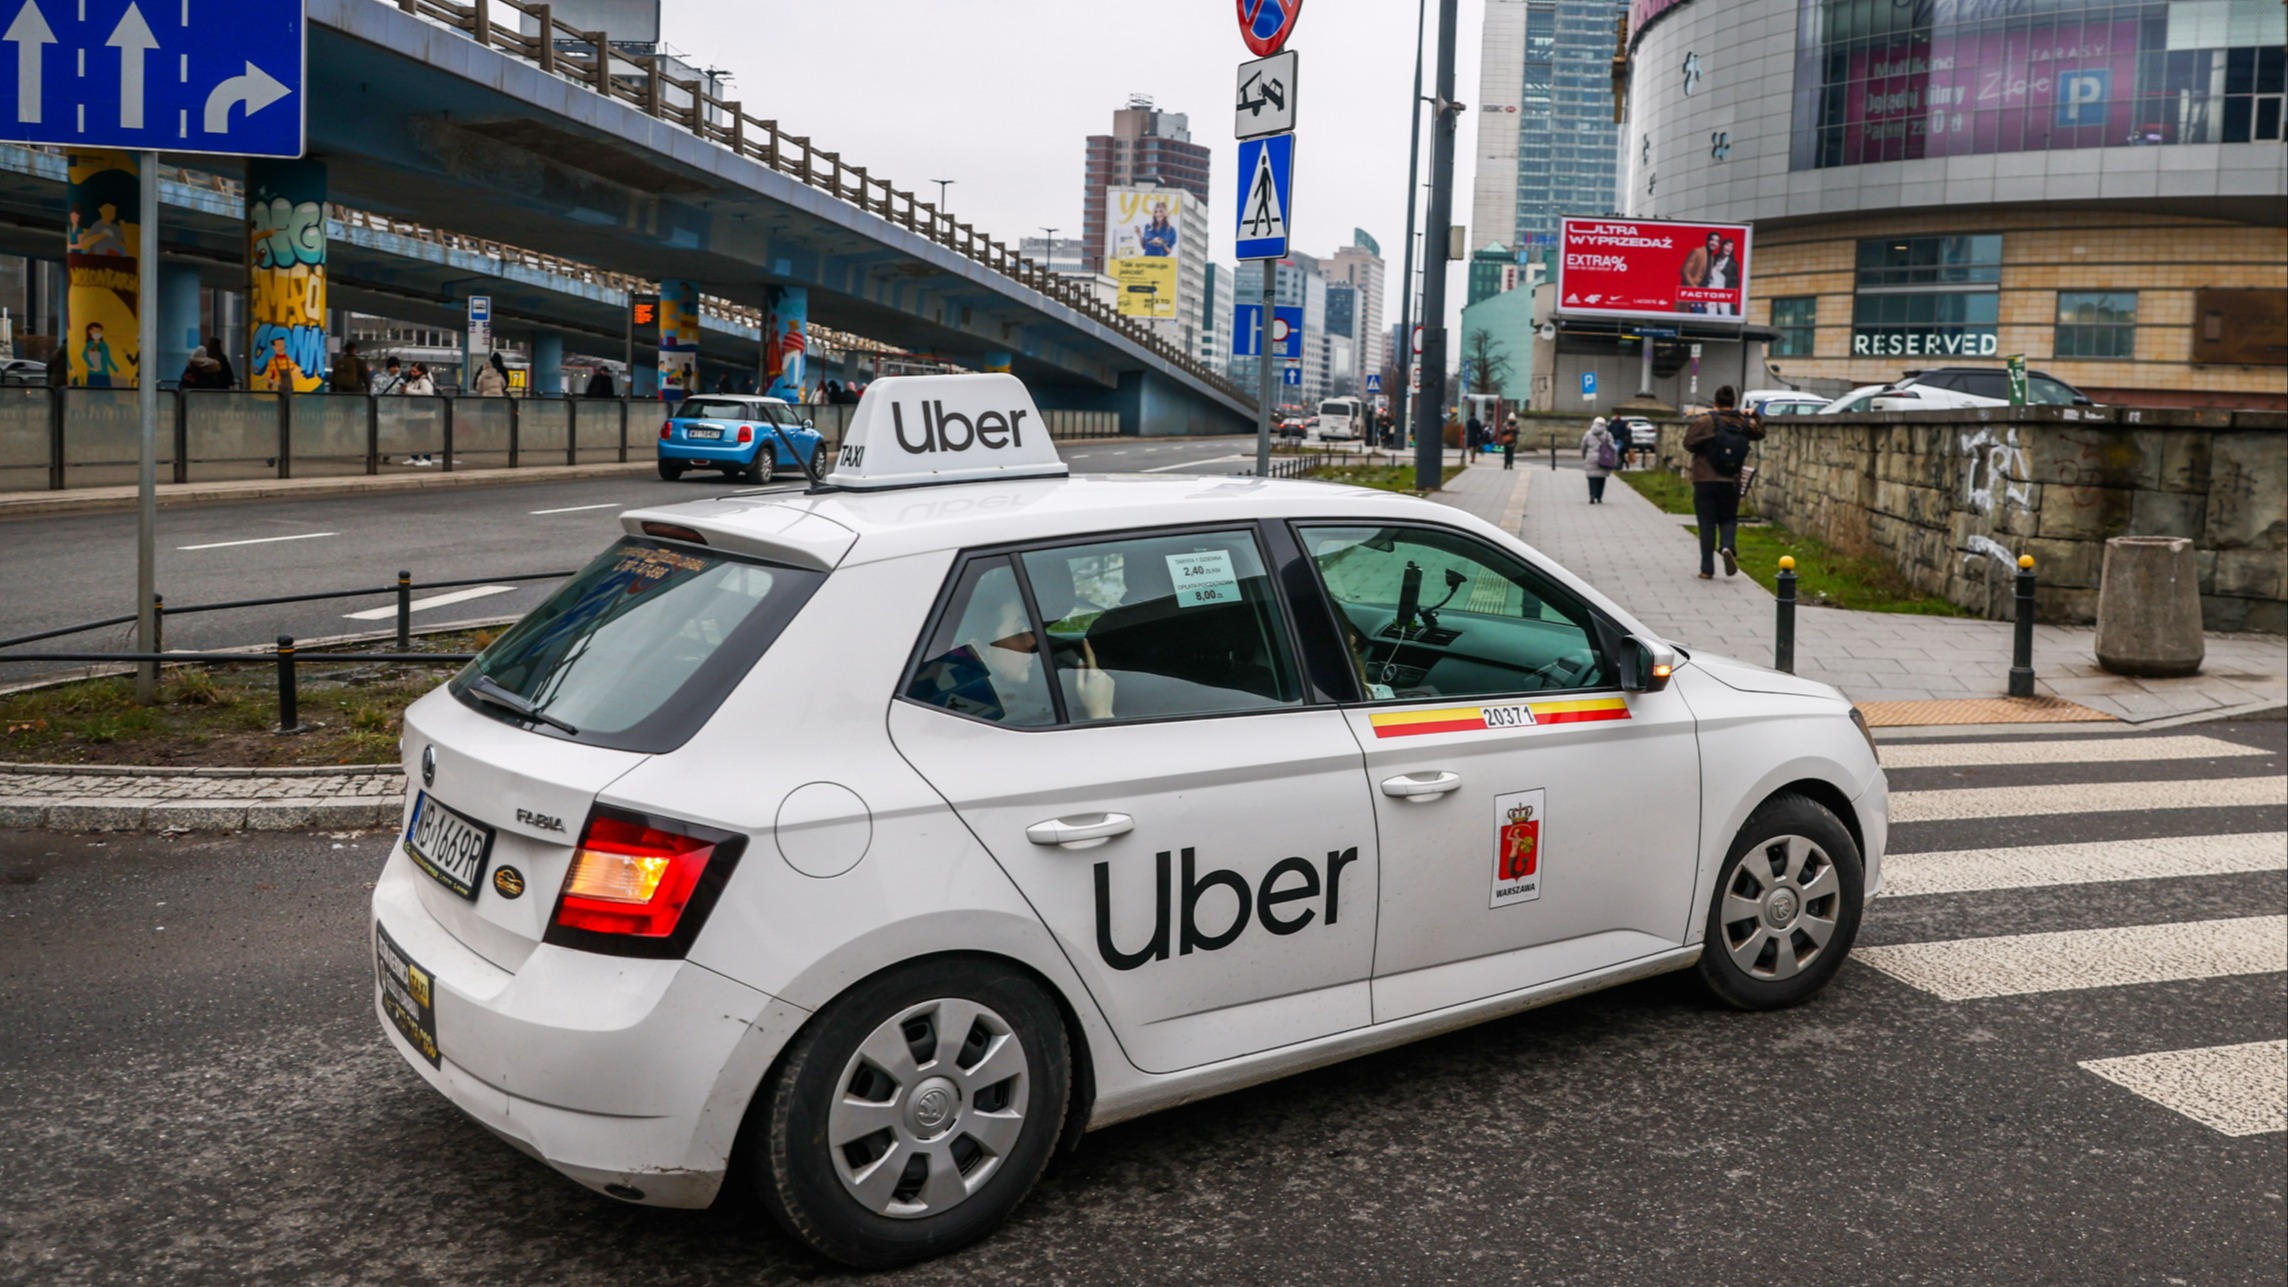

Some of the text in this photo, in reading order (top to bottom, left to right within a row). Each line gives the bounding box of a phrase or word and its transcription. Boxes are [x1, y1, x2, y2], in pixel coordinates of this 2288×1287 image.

[1569, 223, 1638, 236] ULTRA
[1569, 234, 1673, 249] WYPRZEDAŻ
[1567, 253, 1628, 272] EXTRA%
[1680, 290, 1733, 299] FACTORY
[1854, 334, 1998, 356] RESERVED
[1584, 374, 1594, 388] P
[892, 400, 1027, 455] Uber
[840, 445, 865, 468] TAXI
[1183, 566, 1204, 577] 2,40
[1195, 590, 1217, 602] 8,00
[1484, 706, 1534, 726] 20371
[517, 808, 566, 833] FABIA
[432, 815, 483, 882] 1669R
[1496, 883, 1536, 898] WARSZAWA
[1093, 846, 1358, 971] Uber
[411, 973, 428, 999] TAXI
